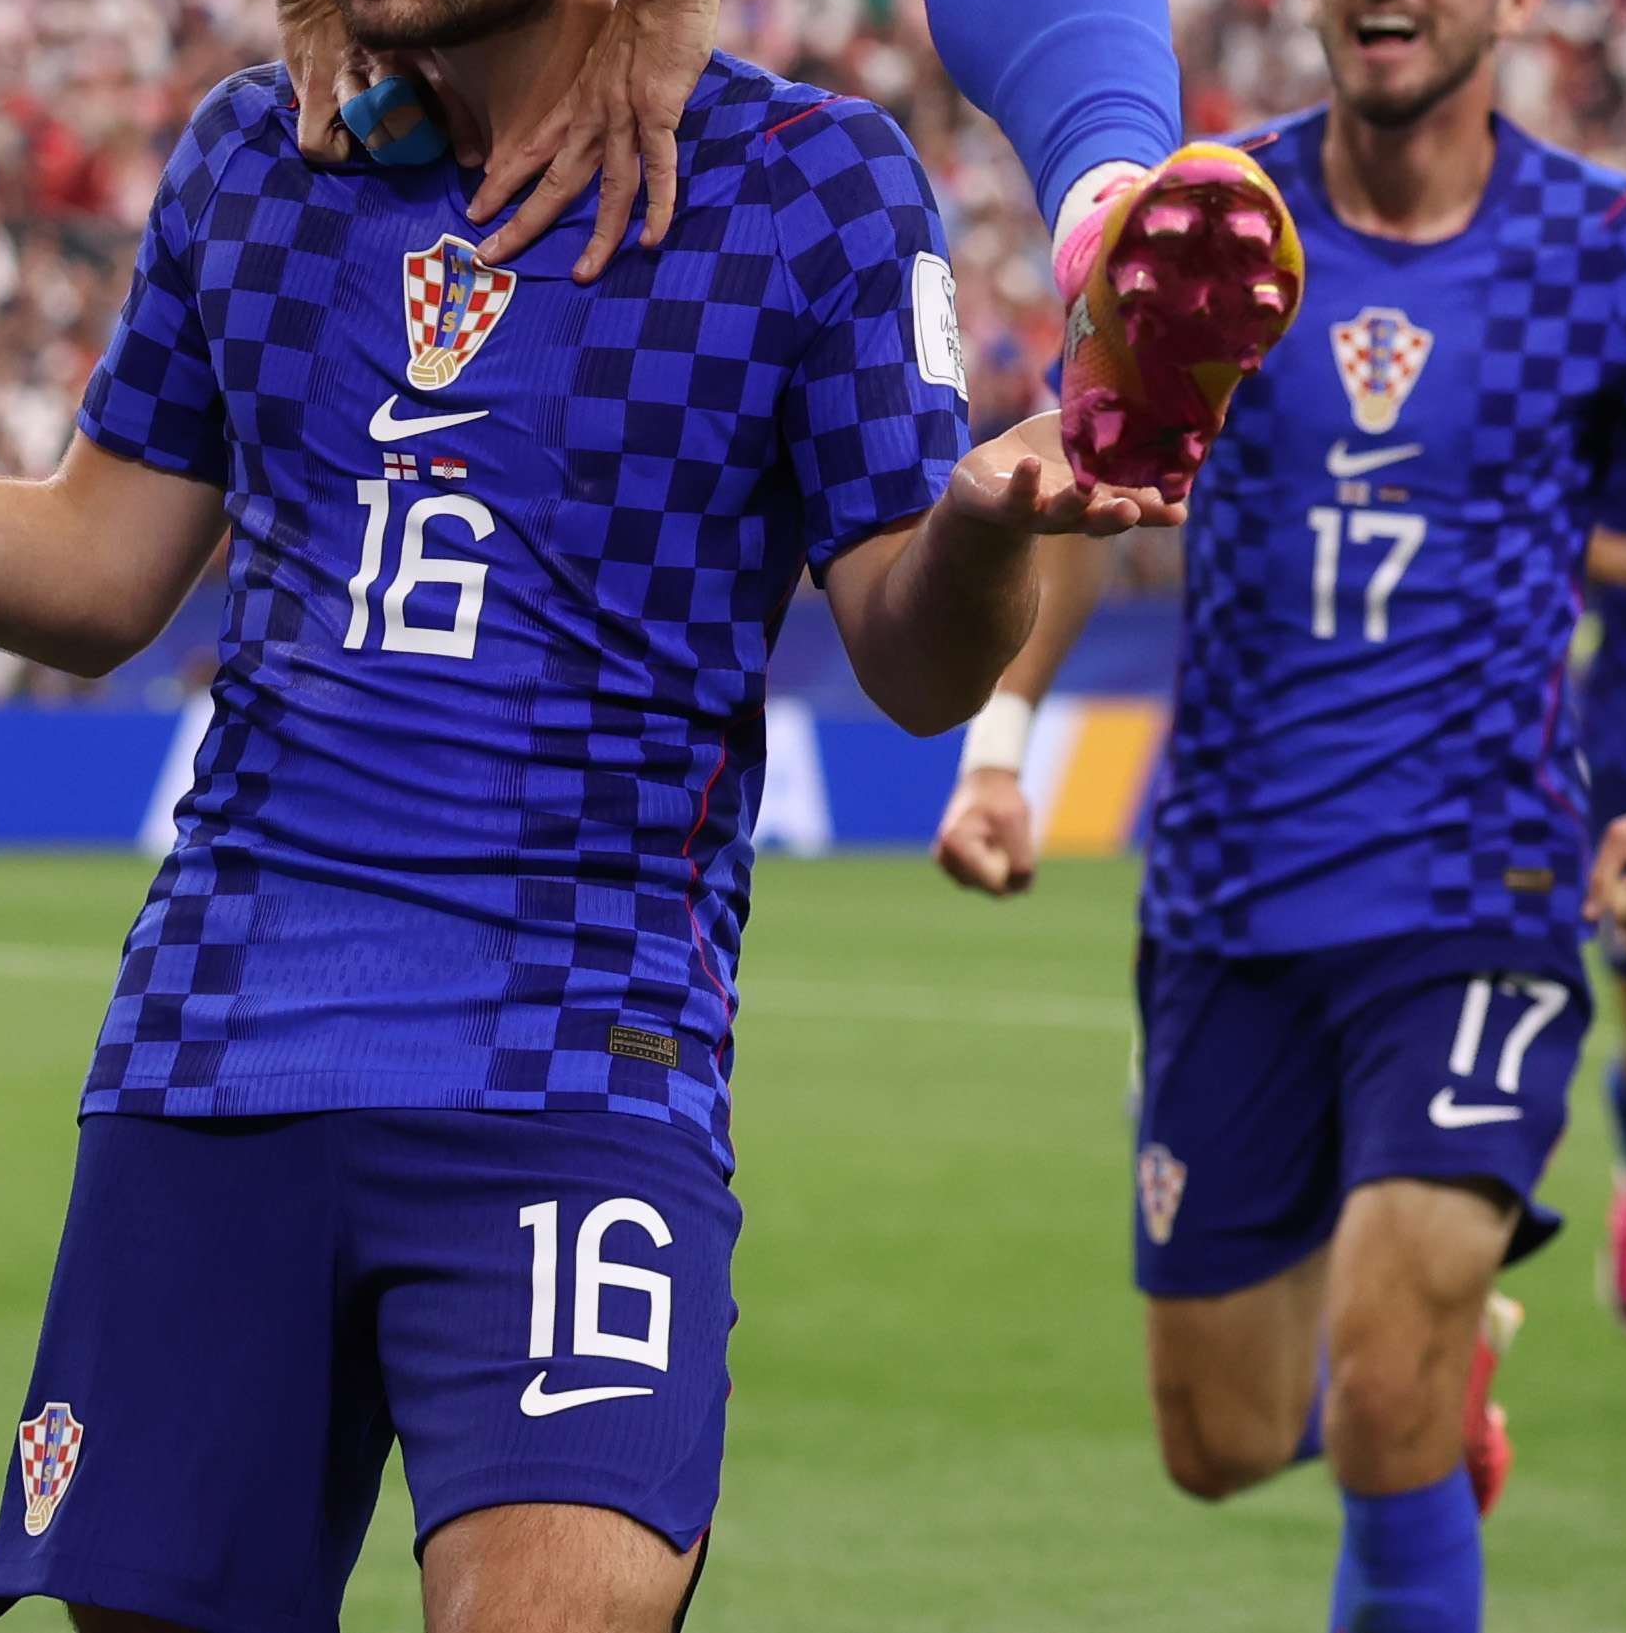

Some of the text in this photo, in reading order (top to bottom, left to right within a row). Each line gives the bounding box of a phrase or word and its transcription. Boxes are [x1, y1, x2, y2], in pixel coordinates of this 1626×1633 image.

[343, 479, 495, 659] 16
[1307, 506, 1426, 643] 17
[1449, 979, 1570, 1095] 17
[520, 1197, 673, 1372] 16
